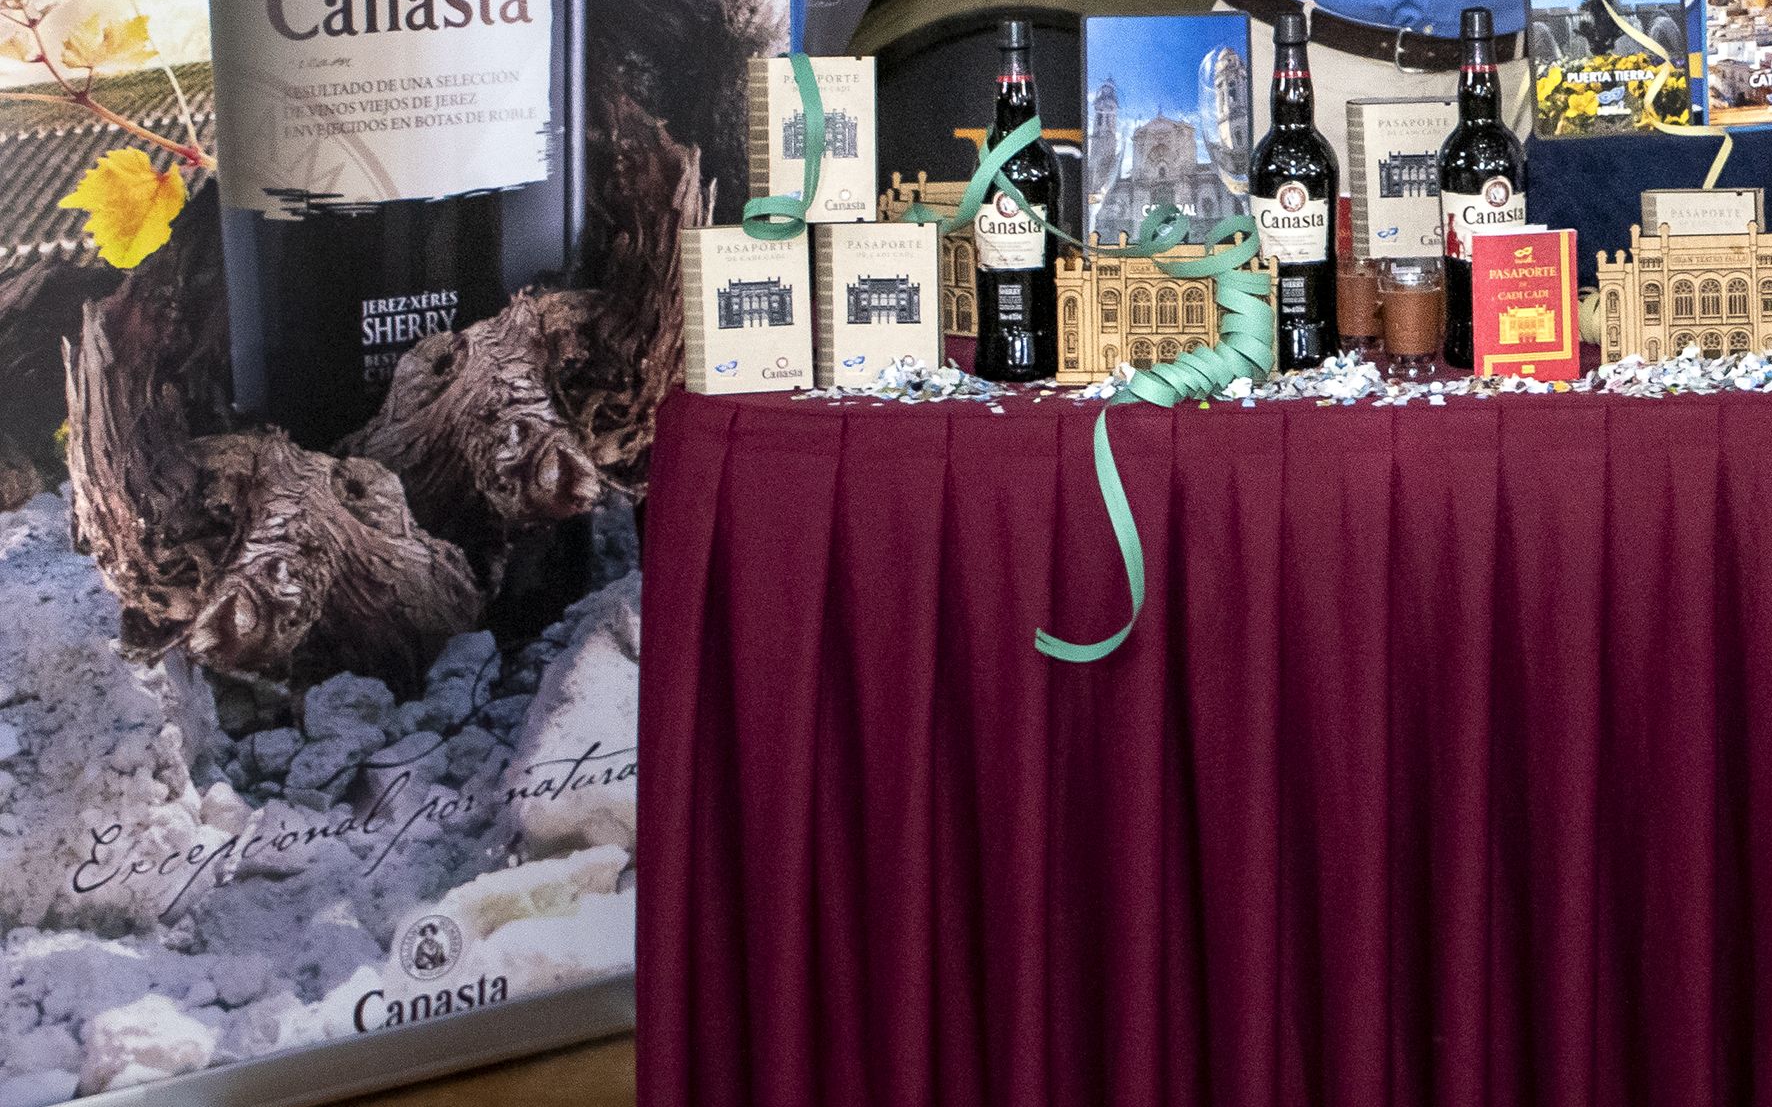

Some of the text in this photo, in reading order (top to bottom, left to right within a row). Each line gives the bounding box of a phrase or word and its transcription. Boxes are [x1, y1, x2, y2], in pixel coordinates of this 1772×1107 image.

[376, 78, 397, 92] DE
[399, 76, 434, 92] UNA
[1566, 69, 1656, 83] PUERTA TIERRA
[359, 97, 410, 116] VIEJOS
[411, 95, 433, 109] DE
[434, 93, 479, 110] JEREZ
[390, 117, 412, 130] EN
[414, 112, 463, 128] BOTAS
[1377, 117, 1449, 128] PASAPORTE
[1260, 209, 1325, 229] Canasta
[1462, 205, 1525, 225] Canasta
[979, 214, 1042, 235] Canasta
[717, 242, 794, 255] PASAPORTE
[847, 239, 923, 249] PASAPORTE
[1488, 266, 1558, 280] PASAPORTE
[362, 308, 457, 346] SHERRY
[762, 367, 803, 380] Canasta
[72, 741, 638, 922] Excepcional por natura
[353, 973, 508, 1033] Canasta
